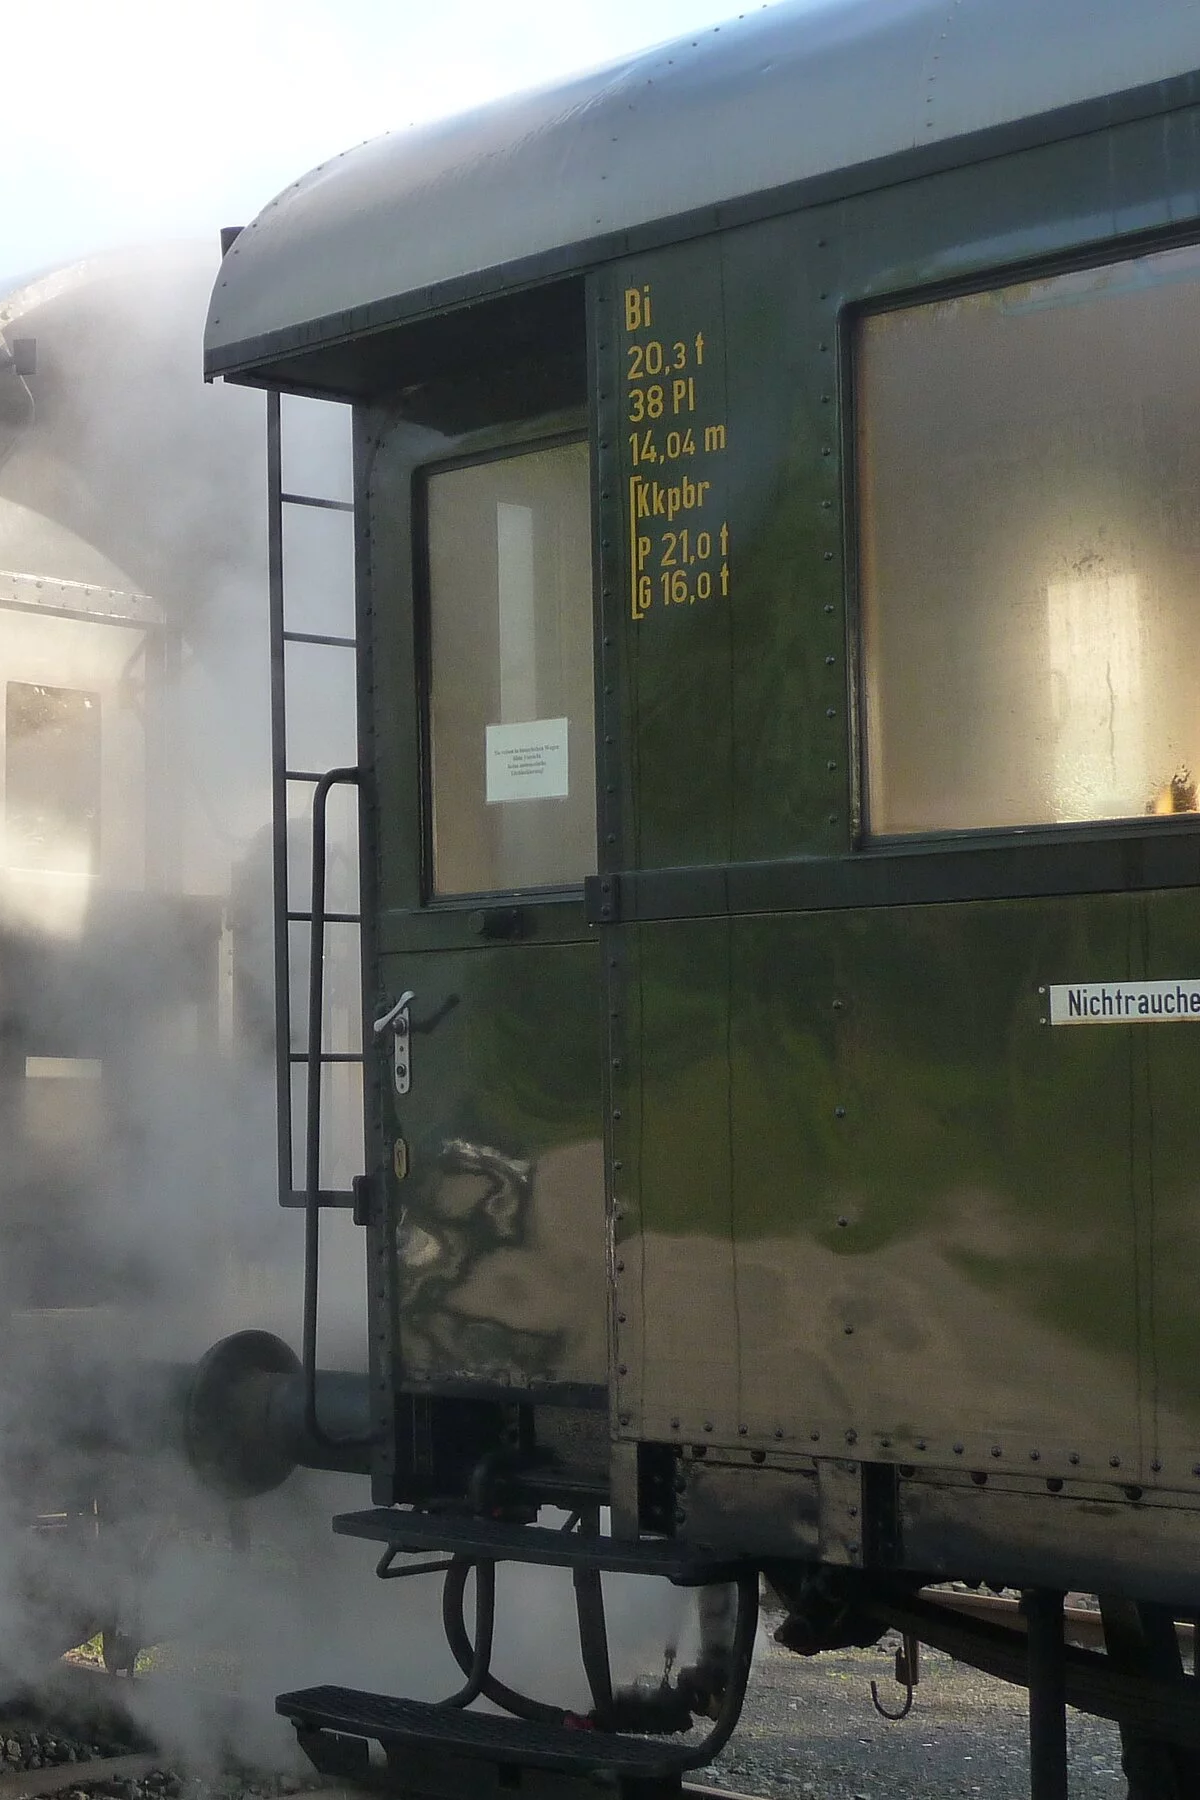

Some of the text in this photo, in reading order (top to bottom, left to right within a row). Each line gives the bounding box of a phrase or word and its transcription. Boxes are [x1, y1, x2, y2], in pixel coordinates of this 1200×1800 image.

[625, 285, 651, 332] Bi
[627, 331, 704, 380] 20,3 t
[628, 377, 695, 422] 38 Pl
[628, 424, 726, 466] 14,04 m
[638, 521, 728, 571] P 21,0 t
[639, 562, 729, 609] G 16,0 t
